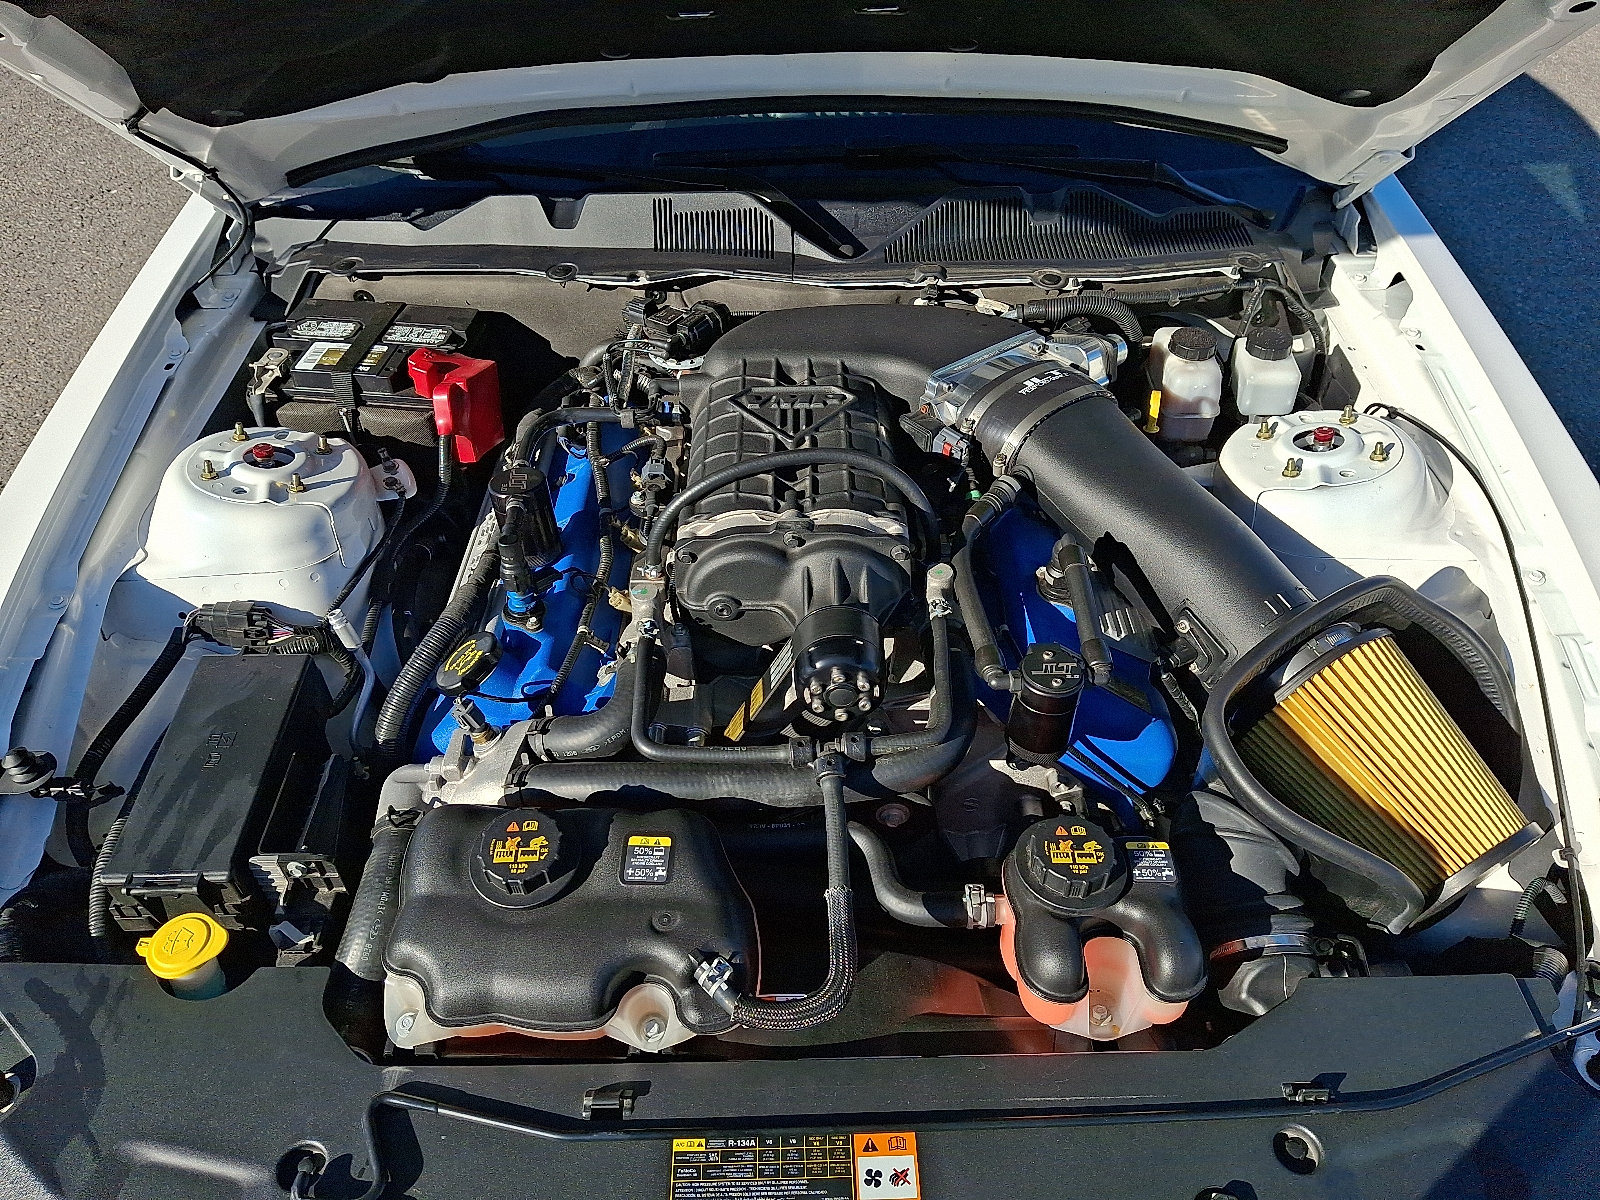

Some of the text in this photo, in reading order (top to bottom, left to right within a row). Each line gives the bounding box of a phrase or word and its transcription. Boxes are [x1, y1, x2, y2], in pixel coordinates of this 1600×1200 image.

[1031, 662, 1078, 676] JLT
[633, 846, 653, 855] 50%
[727, 1139, 756, 1147] R-134A
